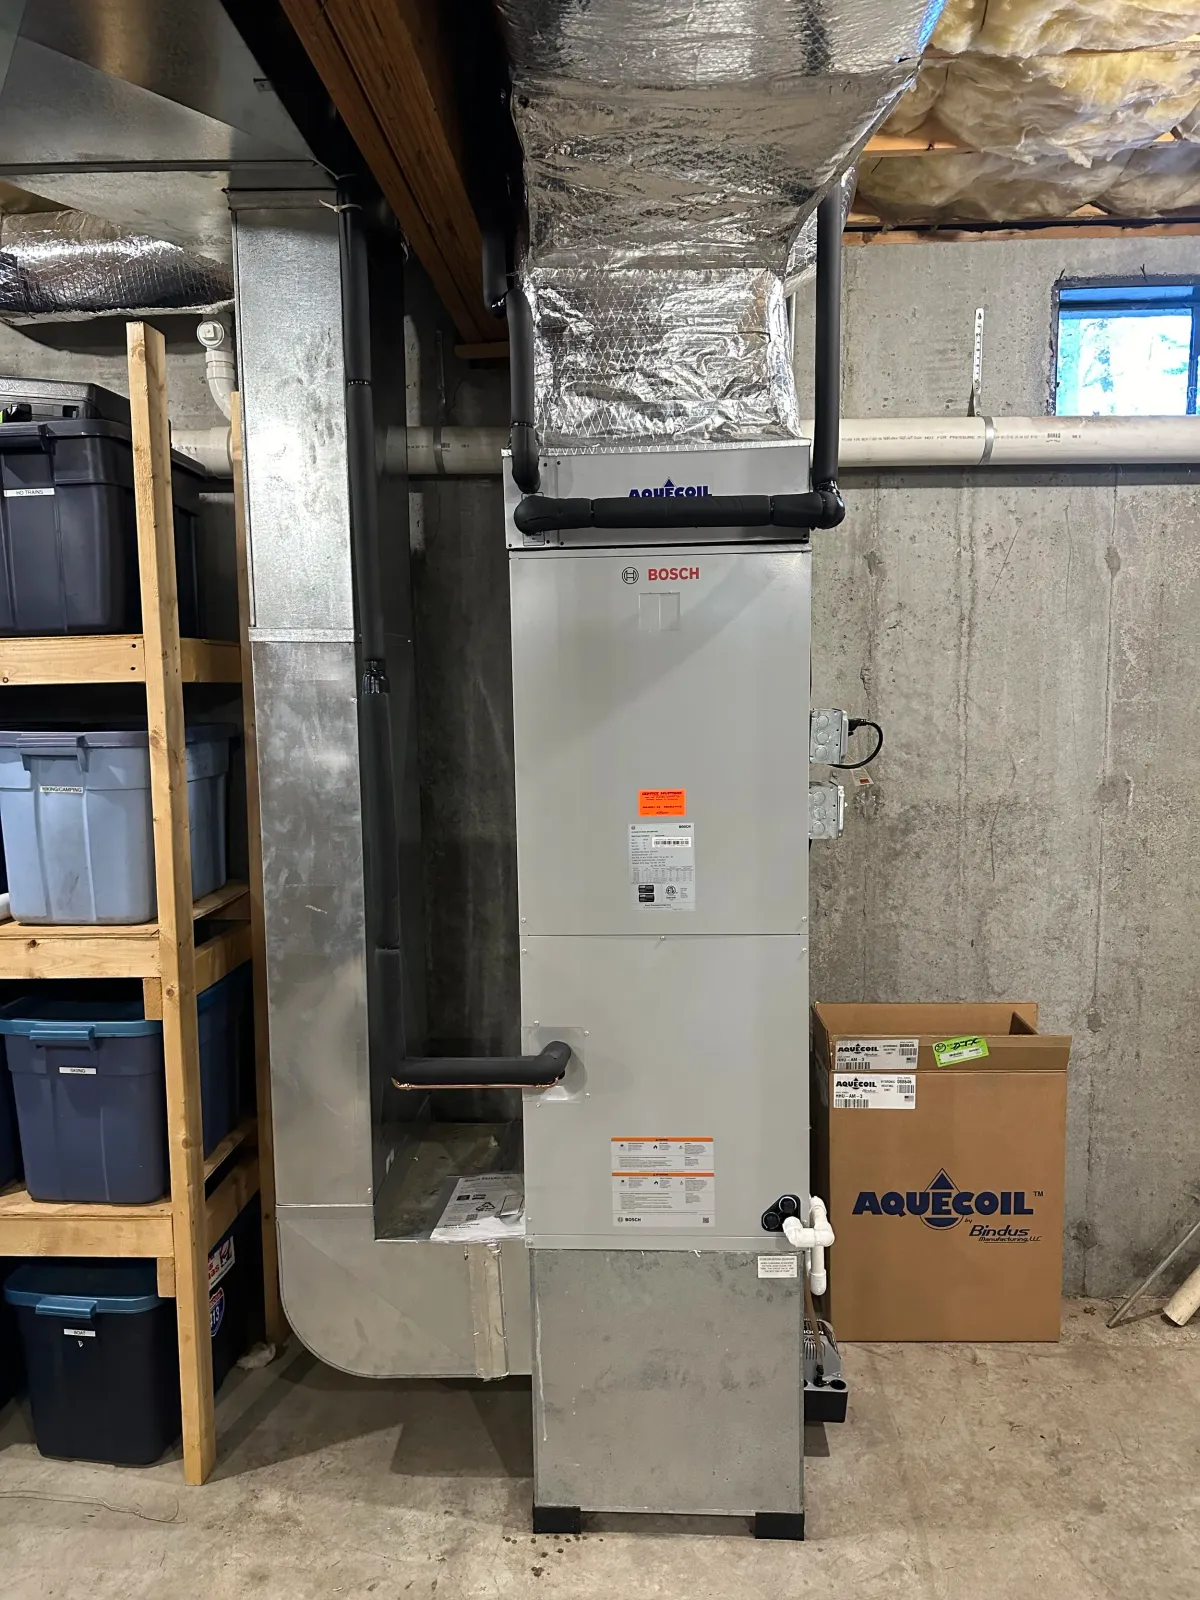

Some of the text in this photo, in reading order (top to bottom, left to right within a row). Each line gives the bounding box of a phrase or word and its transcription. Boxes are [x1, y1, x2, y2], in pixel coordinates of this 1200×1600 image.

[647, 567, 700, 581] BOSCH
[852, 1191, 1034, 1217] AQUECOIL
[969, 1224, 1031, 1236] Bindus
